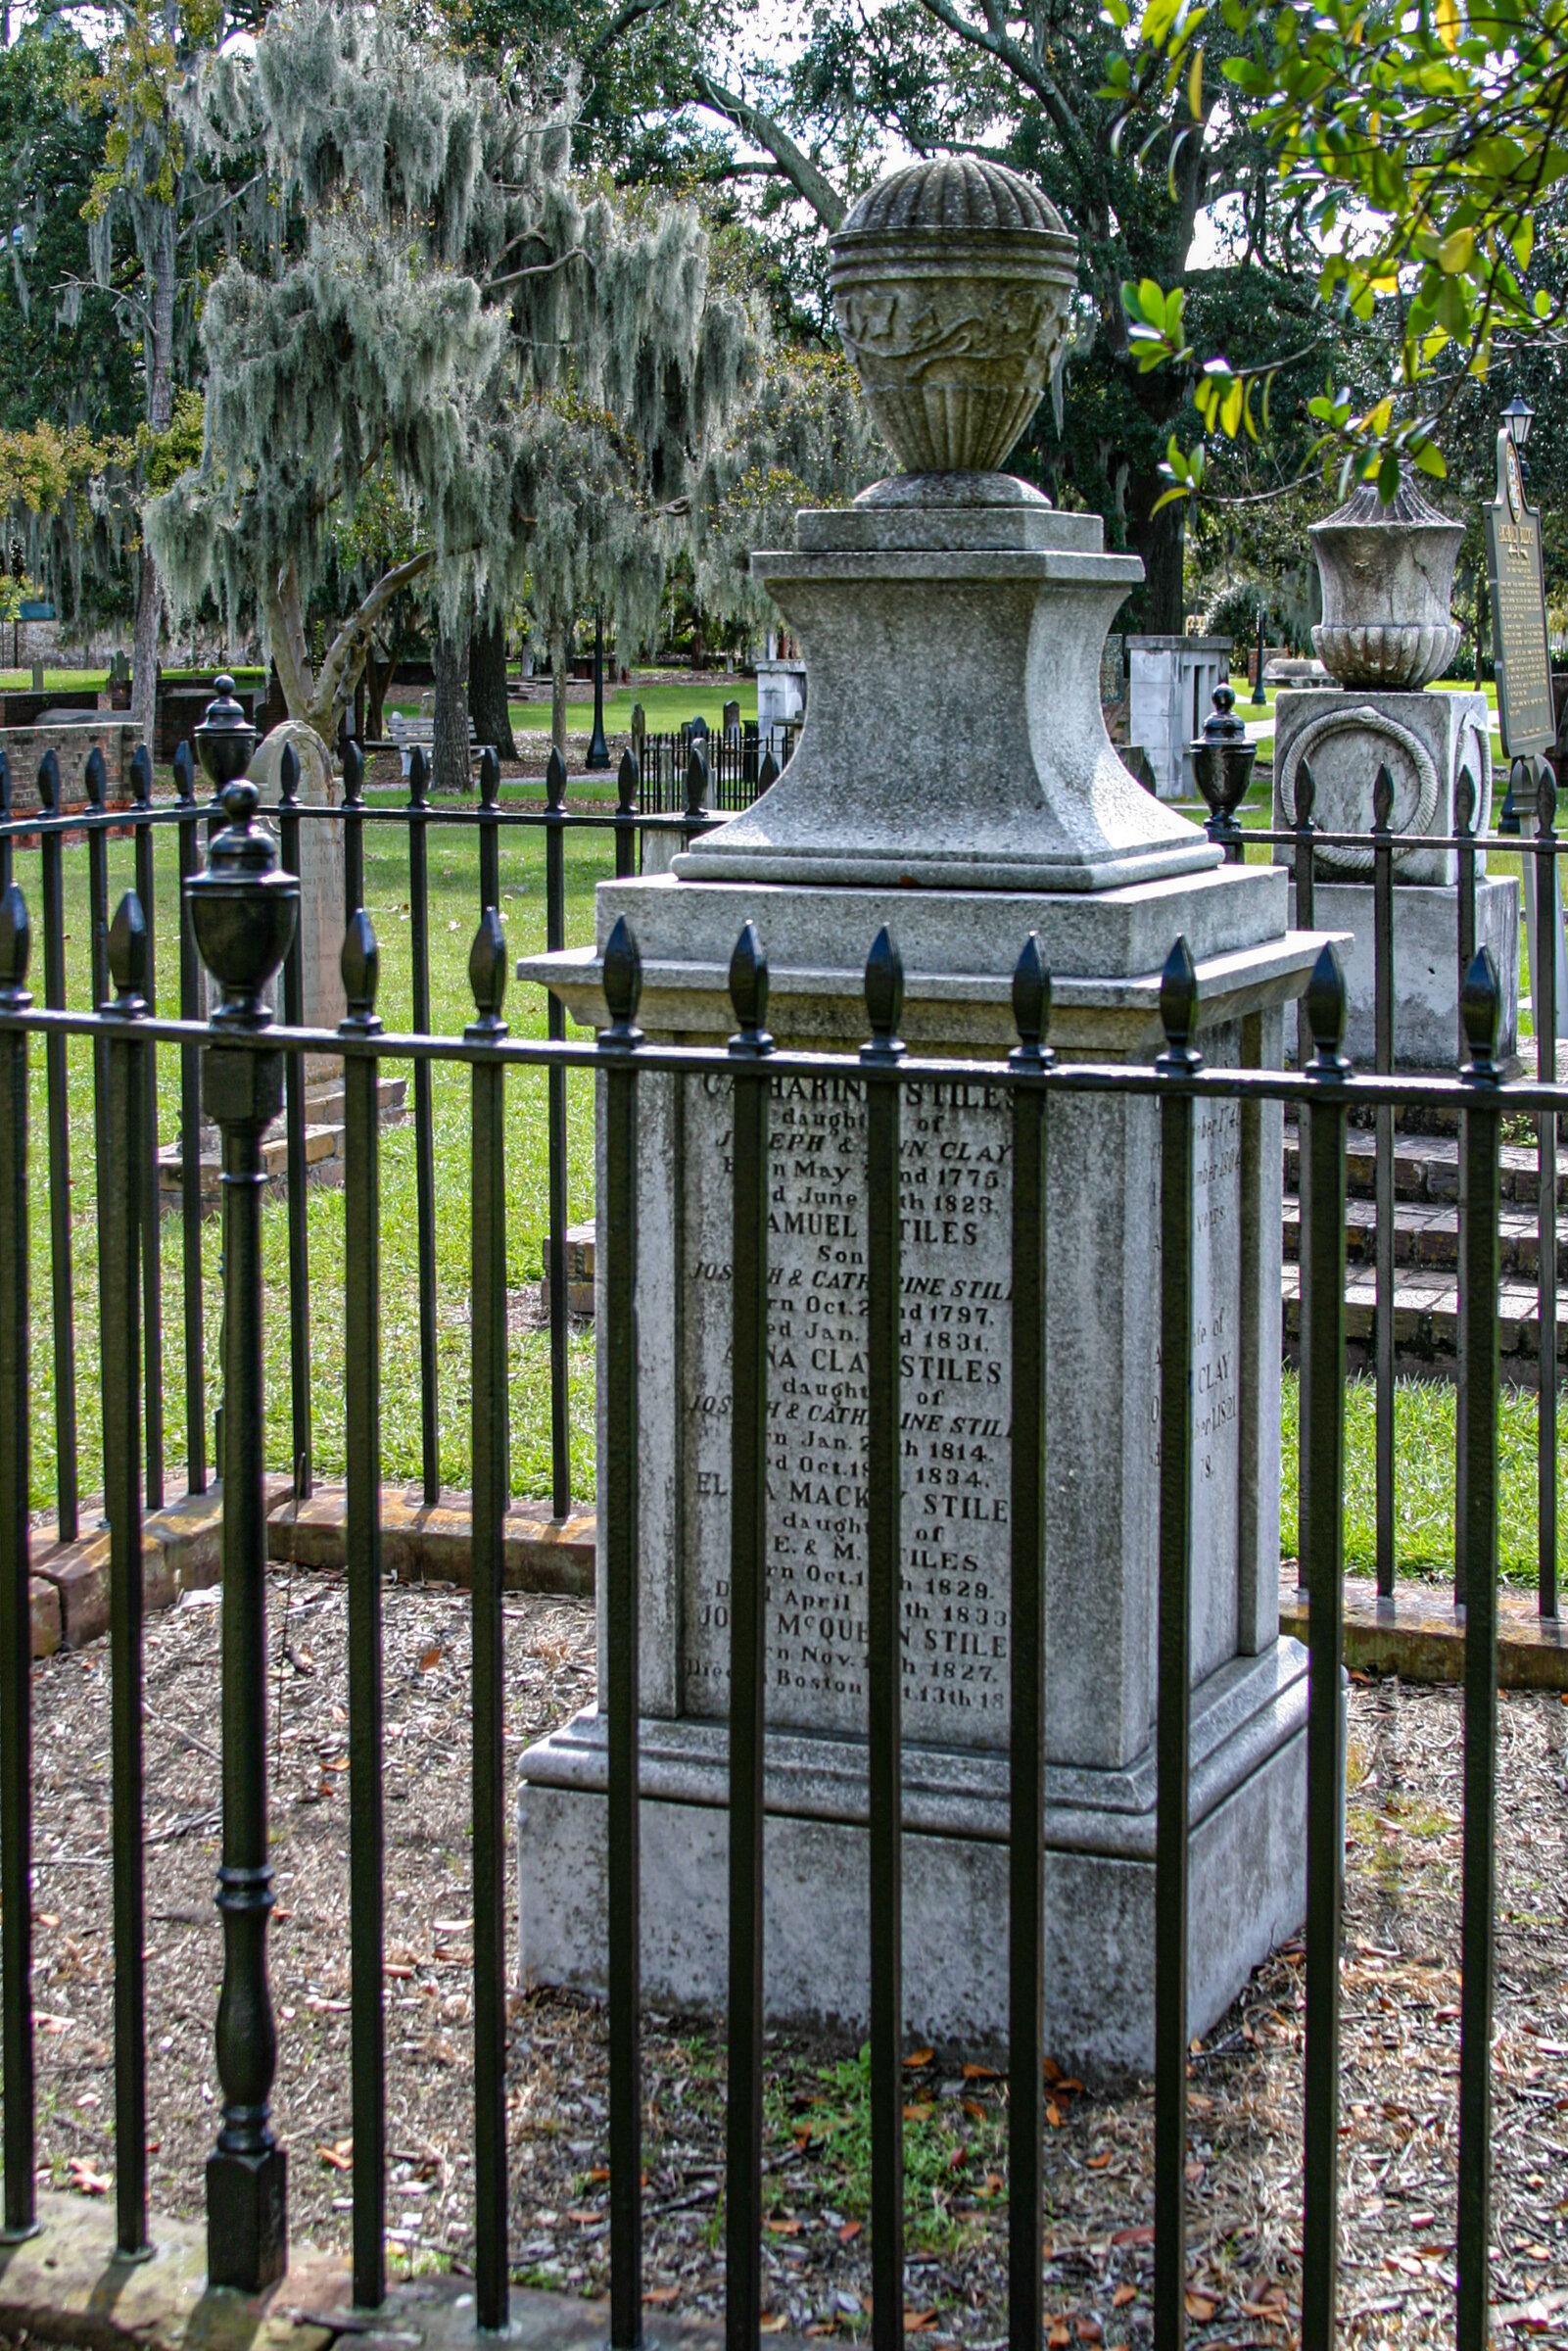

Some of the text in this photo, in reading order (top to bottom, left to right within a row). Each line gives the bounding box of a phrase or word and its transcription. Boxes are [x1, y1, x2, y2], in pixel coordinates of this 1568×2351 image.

[906, 1081, 1016, 1109] STILES
[918, 1115, 944, 1132] of
[716, 1130, 826, 1153] JEPH
[838, 1137, 853, 1154] &
[941, 1142, 1013, 1163] CLAY
[795, 1160, 850, 1185] May
[938, 1167, 1006, 1189] 1775.
[798, 1188, 857, 1206] June
[934, 1194, 999, 1215] 1823.
[767, 1211, 977, 1246] AMUEL TILES
[818, 1246, 864, 1264] Son
[693, 1263, 784, 1286] JOSH
[789, 1270, 802, 1286] &
[950, 1280, 1013, 1302] STIL
[930, 1305, 995, 1325] 1797.
[805, 1325, 859, 1343] Jan.
[924, 1332, 988, 1353] 1831.
[900, 1355, 1002, 1384] STILES
[1199, 1350, 1231, 1394] CLAY
[918, 1389, 944, 1406] of
[689, 1394, 1012, 1439] JOSH & CATHINE STIL
[801, 1431, 852, 1450] Jan.
[929, 1441, 994, 1463] 1814.
[917, 1466, 989, 1489] 1834.
[924, 1494, 1009, 1523] STILE
[917, 1526, 944, 1543] of
[804, 1540, 817, 1556] &
[833, 1542, 861, 1560] M.
[784, 1588, 850, 1611] April
[927, 1579, 995, 1600] 1829.
[925, 1628, 1007, 1658] STILE
[801, 1647, 854, 1667] Nov.
[931, 1662, 997, 1683] 1827.
[777, 1669, 862, 1695] Boston
